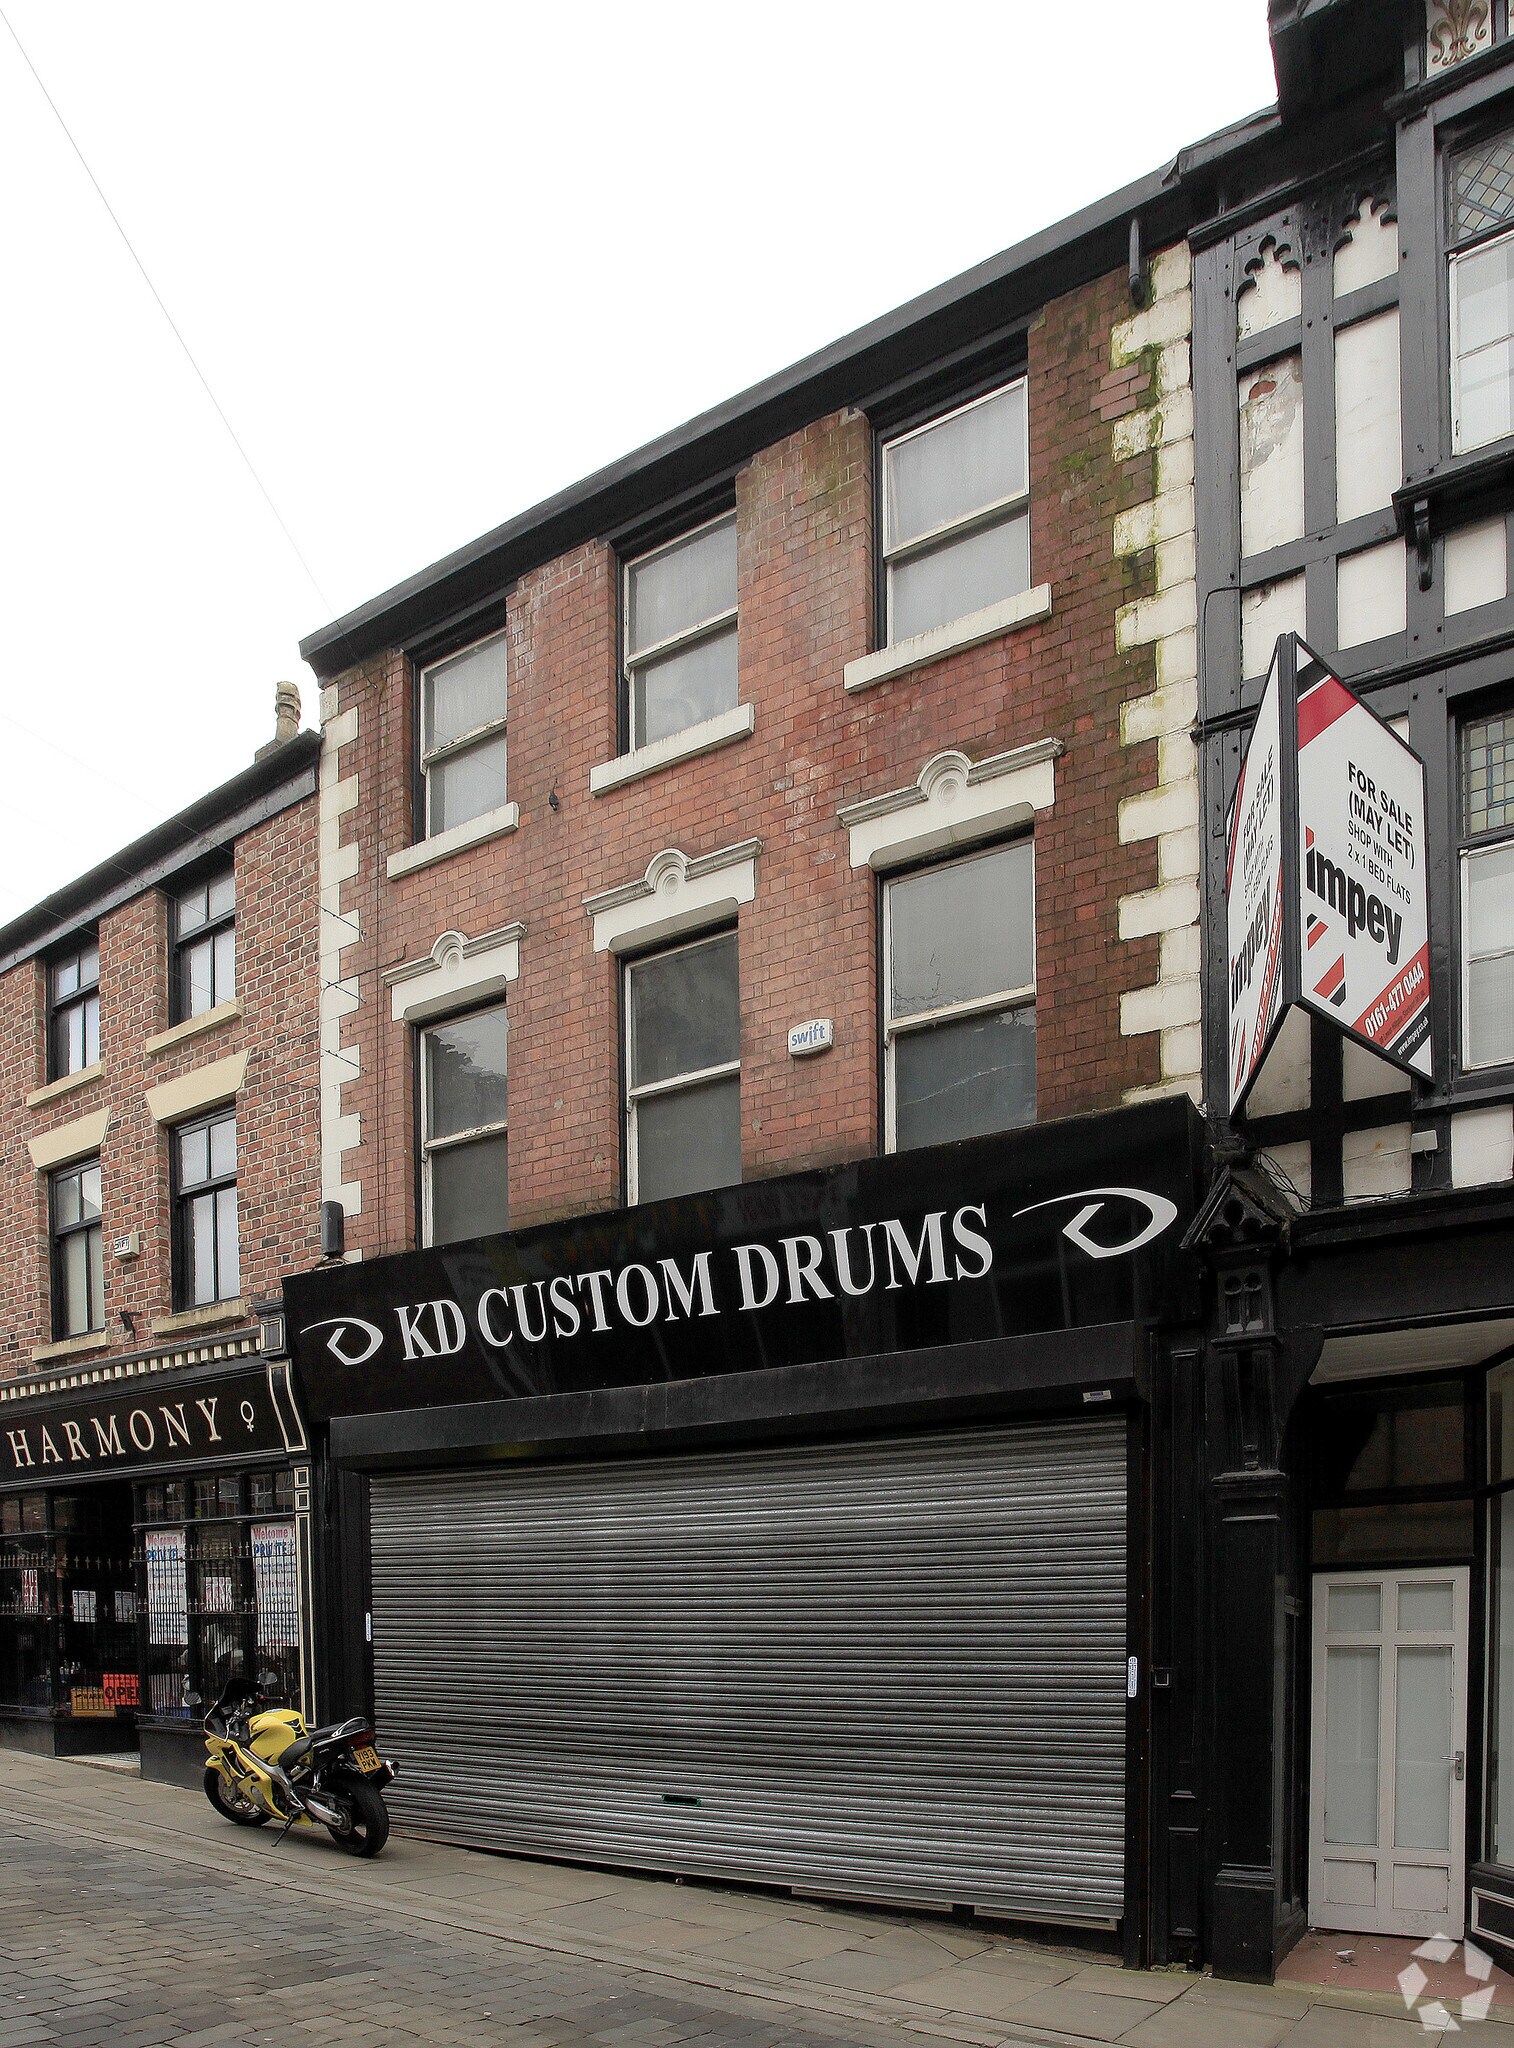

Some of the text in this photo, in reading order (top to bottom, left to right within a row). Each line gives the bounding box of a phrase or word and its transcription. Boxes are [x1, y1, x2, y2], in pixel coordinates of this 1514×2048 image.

[1348, 760, 1413, 837] FOR SALE
[1349, 790, 1415, 869] (MAY LET)
[1348, 820, 1393, 869] SHOP WITH
[1348, 842, 1411, 905] 2 x 1 BED FLATS
[1306, 826, 1402, 965] impey
[1231, 875, 1270, 1014] impey
[791, 1021, 826, 1047] swift
[1364, 981, 1405, 1038] 0161-477
[1403, 961, 1425, 996] 0444
[393, 1203, 993, 1361] KD CUSTOM DRUMS
[6, 1397, 222, 1468] HARMONY
[253, 1525, 289, 1540] Welcome
